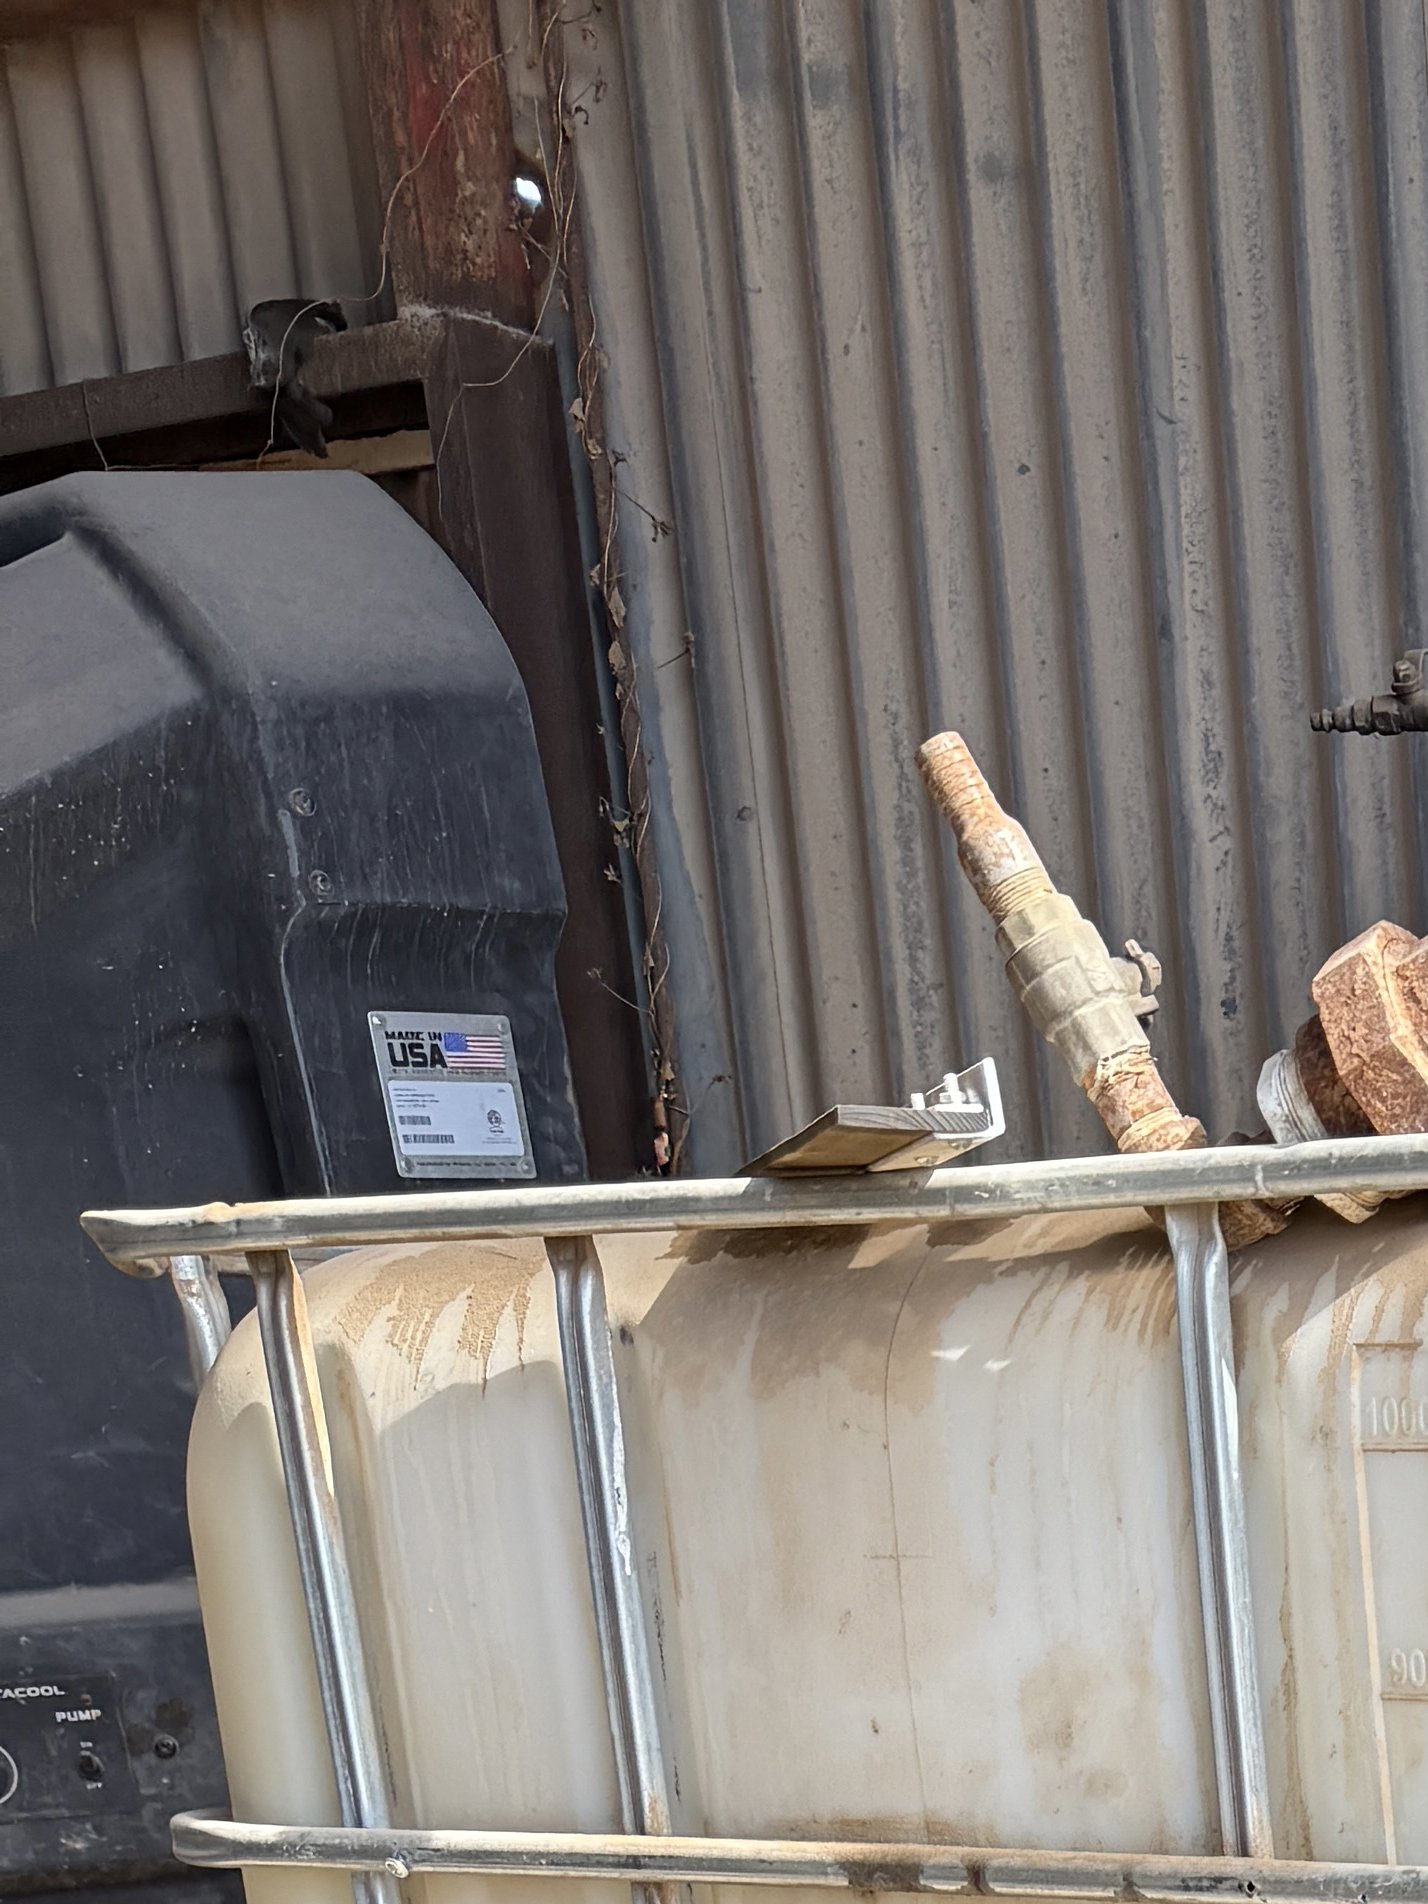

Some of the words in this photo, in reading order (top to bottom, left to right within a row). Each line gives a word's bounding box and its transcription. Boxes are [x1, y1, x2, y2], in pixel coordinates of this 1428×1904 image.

[384, 1030, 425, 1042] MADE
[428, 1031, 443, 1042] IN
[388, 1042, 449, 1069] USA
[55, 1708, 102, 1723] PUMP
